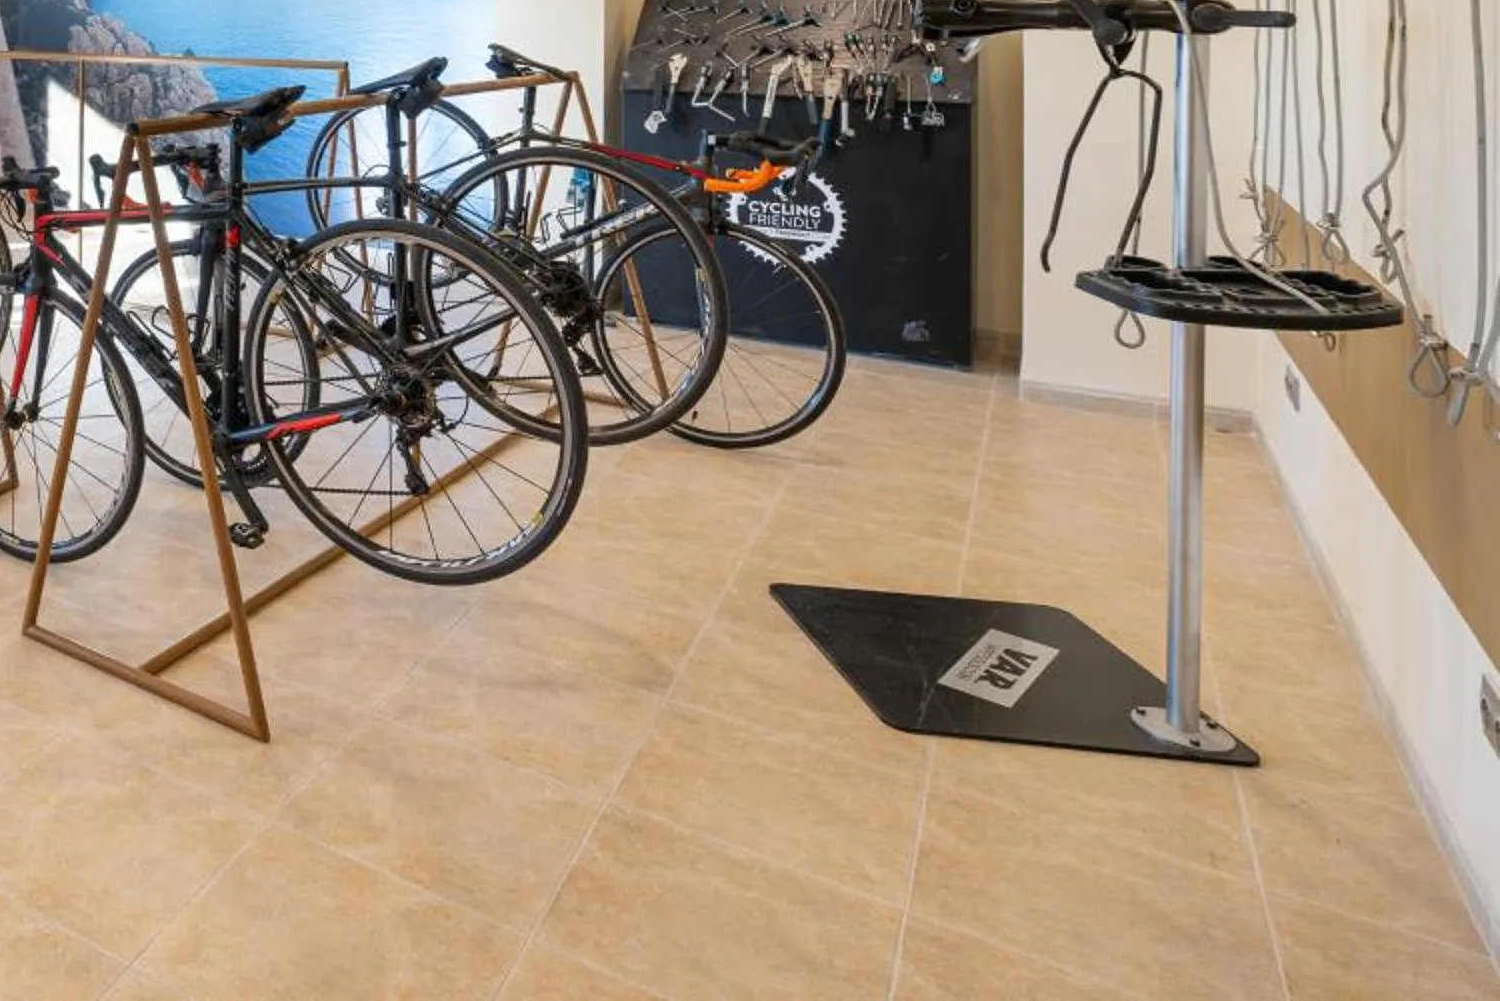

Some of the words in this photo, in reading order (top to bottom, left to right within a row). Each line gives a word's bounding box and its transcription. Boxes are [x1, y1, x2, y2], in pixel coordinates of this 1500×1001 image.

[748, 200, 821, 218] CYCLING
[749, 212, 821, 230] FRIENDLY
[973, 648, 1039, 689] VAR
